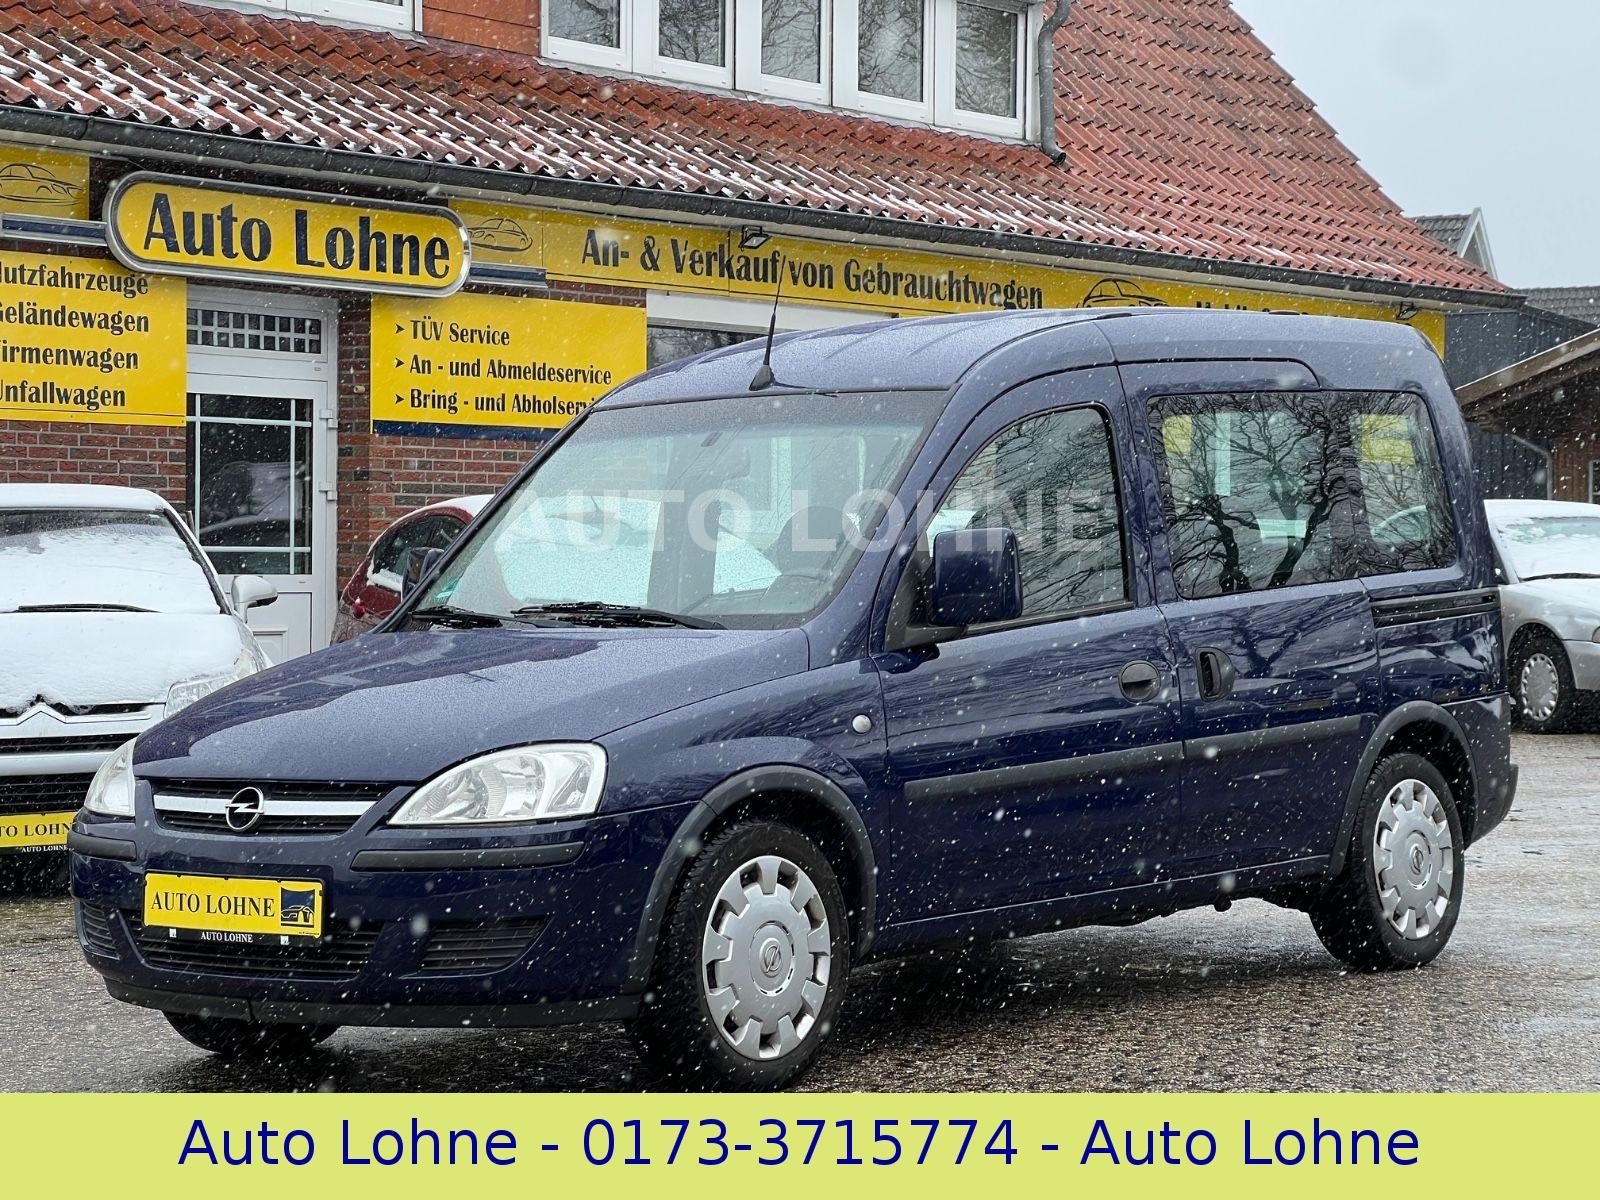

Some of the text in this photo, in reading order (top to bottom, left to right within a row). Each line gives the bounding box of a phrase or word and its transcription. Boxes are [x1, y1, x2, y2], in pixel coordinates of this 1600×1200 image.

[144, 193, 450, 279] Auto Lohne
[0, 261, 149, 298] utzfahrzeuge
[581, 229, 1043, 310] An- & Verkauf von Gebrauchtwagen
[410, 316, 510, 346] TÜV Service
[0, 339, 139, 373] irmenwagen
[410, 354, 432, 376] An
[450, 359, 480, 378] und
[487, 361, 612, 385] Abmeldeservice
[410, 389, 458, 415] Bring
[475, 393, 506, 412] und
[151, 891, 275, 917] AUTO LOHNE
[200, 931, 253, 943] AUTO LOHNE
